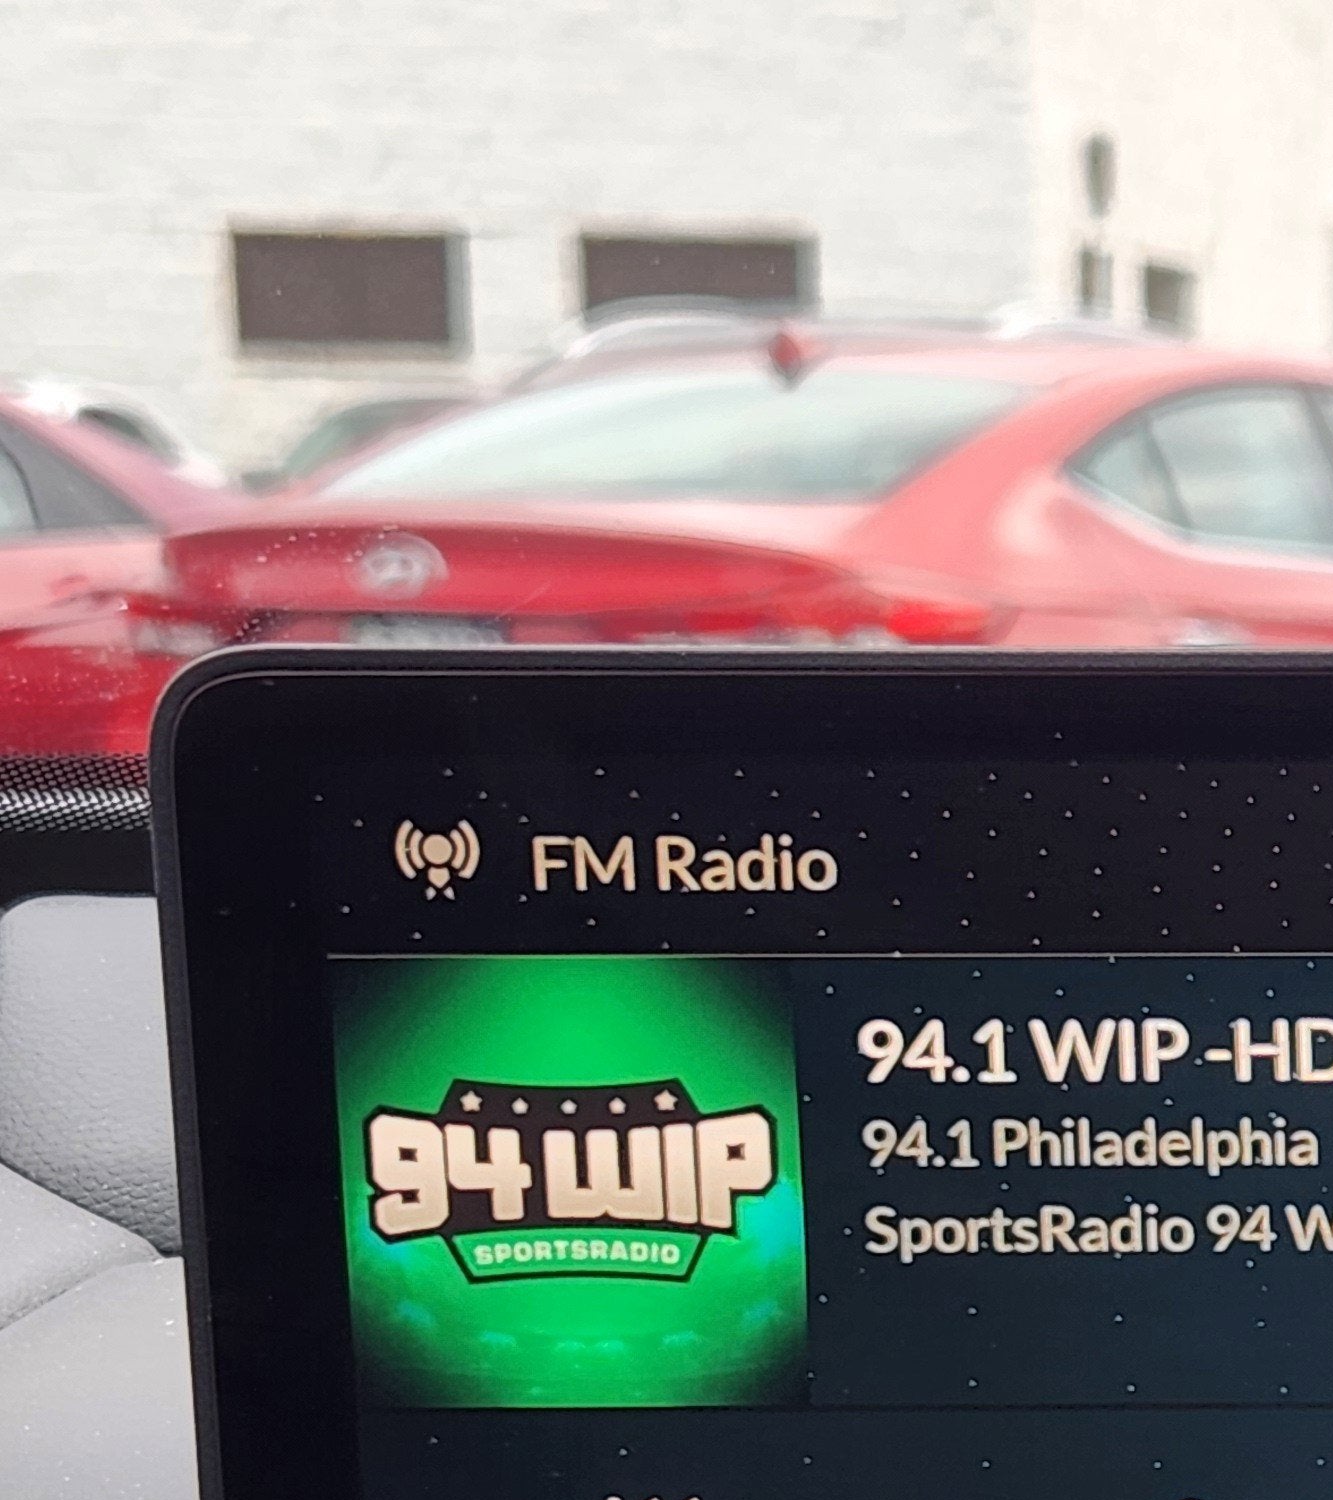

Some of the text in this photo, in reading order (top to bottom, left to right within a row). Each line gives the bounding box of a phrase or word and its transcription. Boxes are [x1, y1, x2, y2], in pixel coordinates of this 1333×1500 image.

[532, 834, 839, 892] FM Radio
[857, 1018, 1018, 1083] 94.1
[368, 1111, 774, 1236] 94 WIP
[862, 1118, 981, 1168] 94.1
[992, 1115, 1320, 1177] Philadelphia
[474, 1240, 681, 1266] SPORTSRADIO
[864, 1202, 1196, 1264] SportsRadio
[1206, 1204, 1278, 1253] 94
